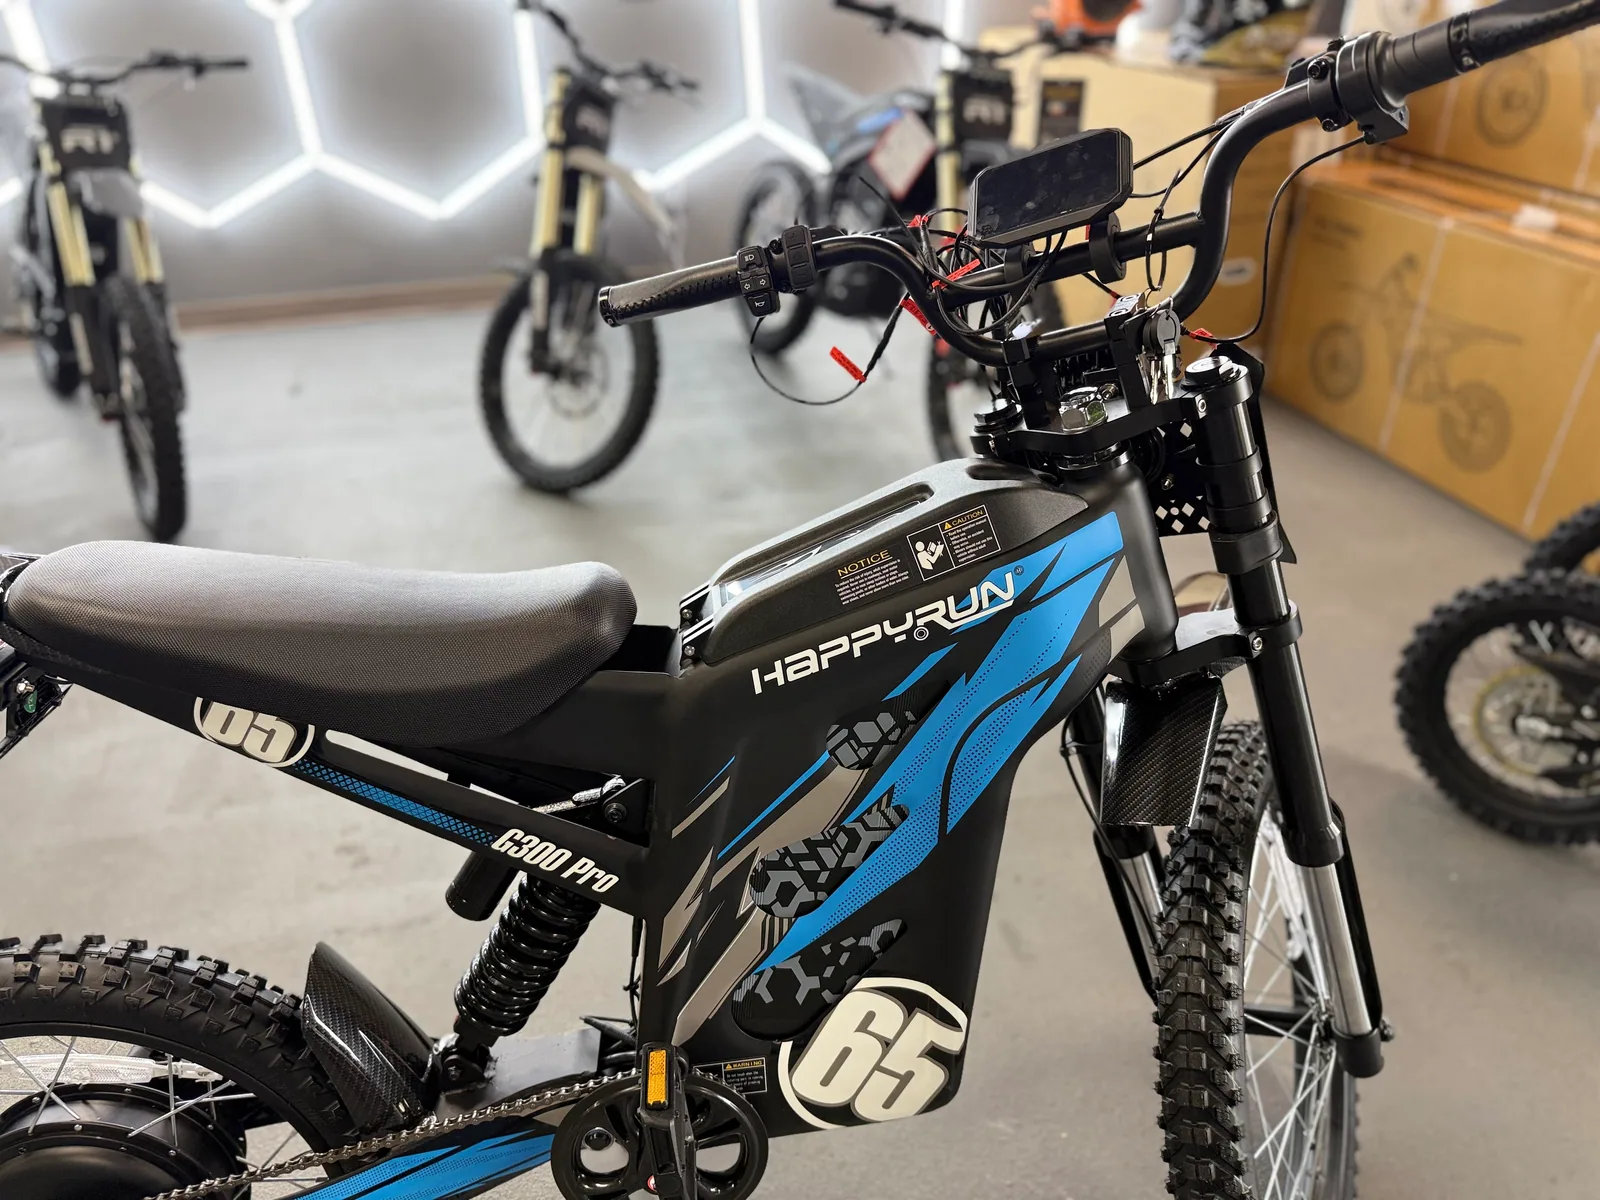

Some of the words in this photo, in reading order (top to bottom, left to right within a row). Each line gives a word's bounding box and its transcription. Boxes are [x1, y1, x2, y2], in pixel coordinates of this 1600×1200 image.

[952, 510, 983, 526] CAUTION
[838, 550, 890, 576] NOTICE
[491, 828, 572, 871] G300
[560, 857, 619, 893] Pro
[790, 988, 966, 1122] 65
